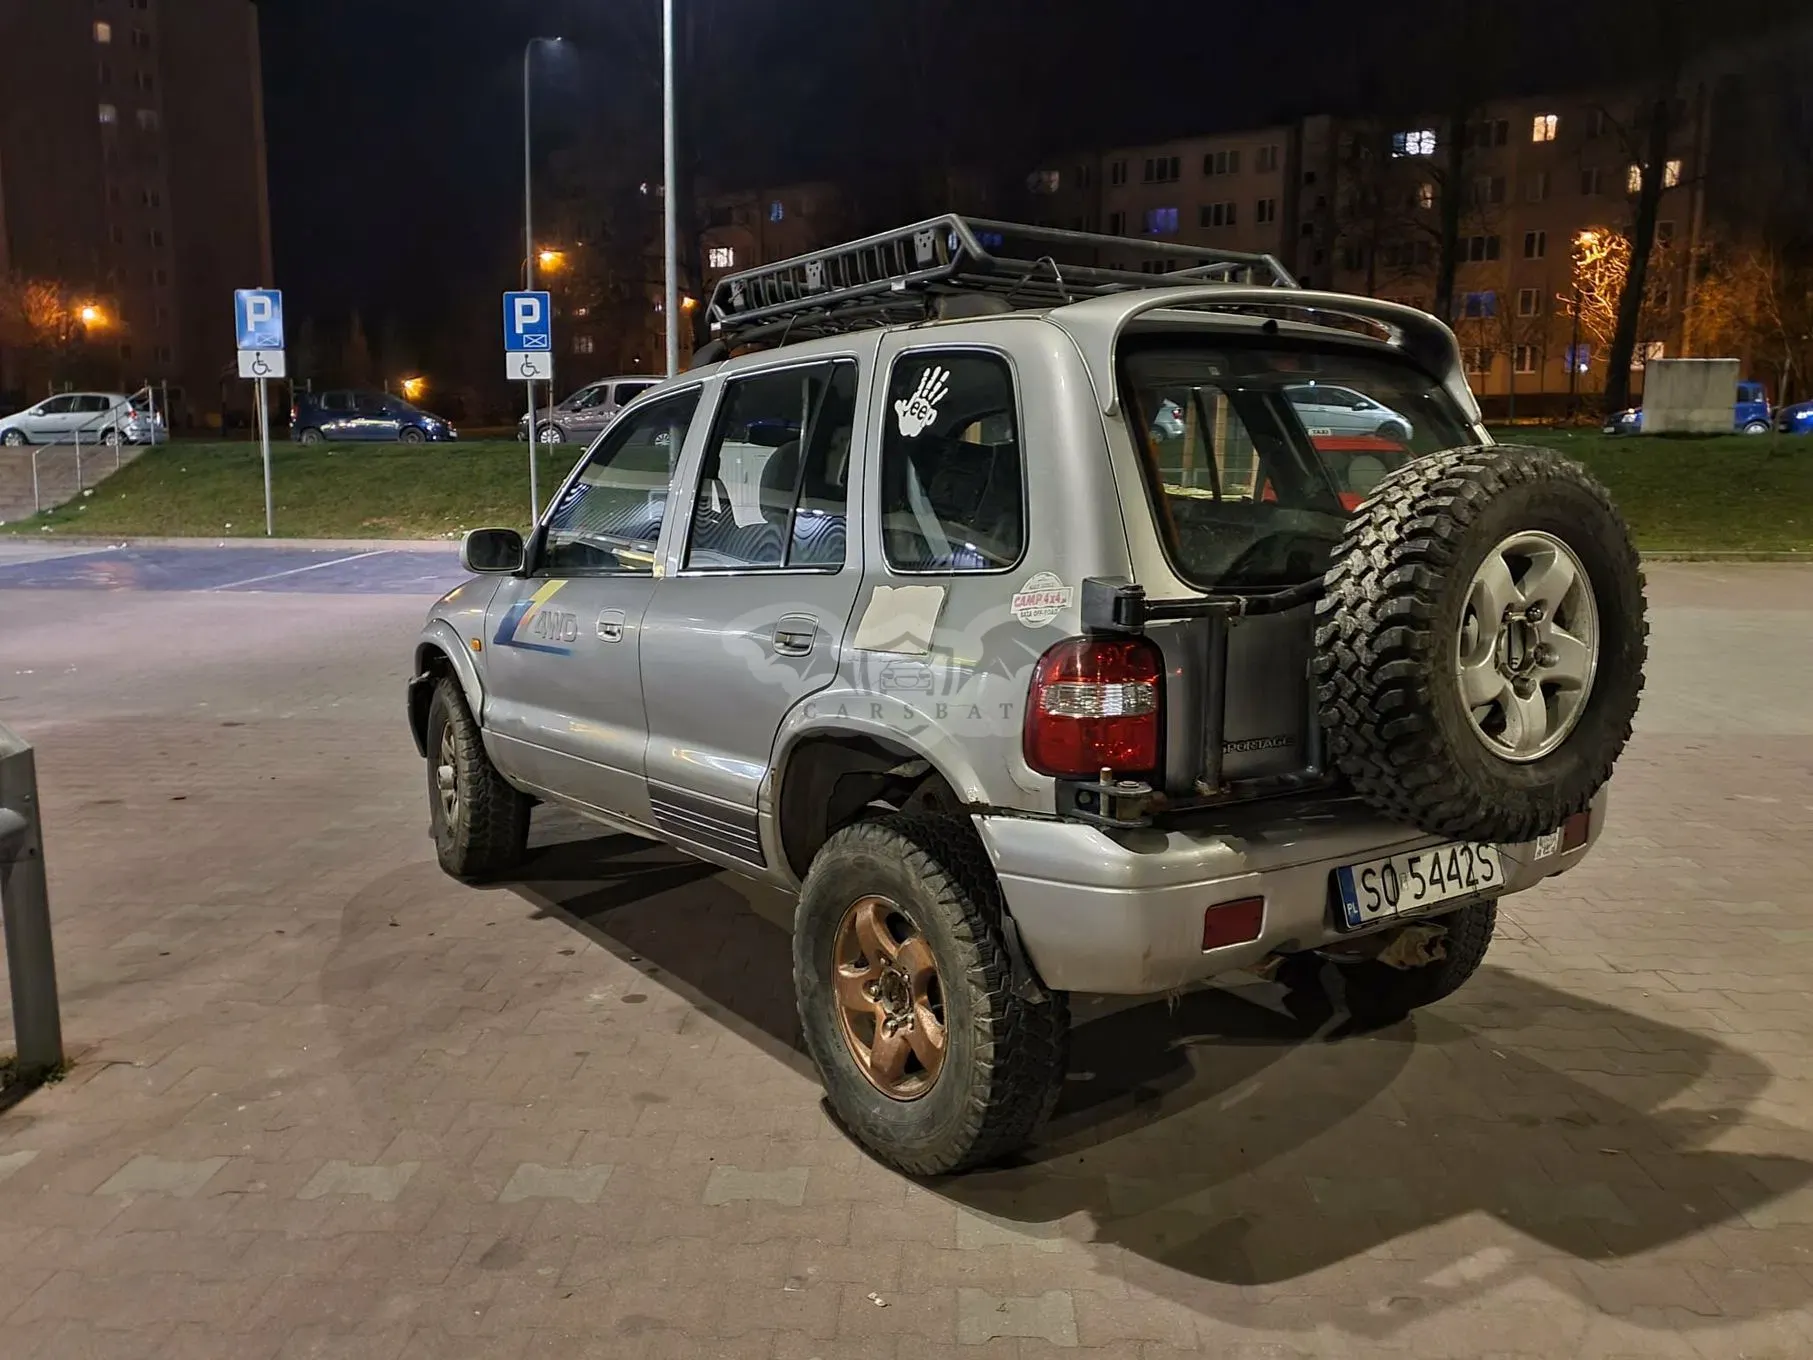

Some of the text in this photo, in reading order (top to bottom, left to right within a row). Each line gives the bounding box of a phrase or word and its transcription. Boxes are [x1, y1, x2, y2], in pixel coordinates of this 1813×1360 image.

[246, 296, 272, 332] P
[514, 297, 540, 334] P
[534, 610, 578, 643] 4WD
[1346, 902, 1359, 915] PL
